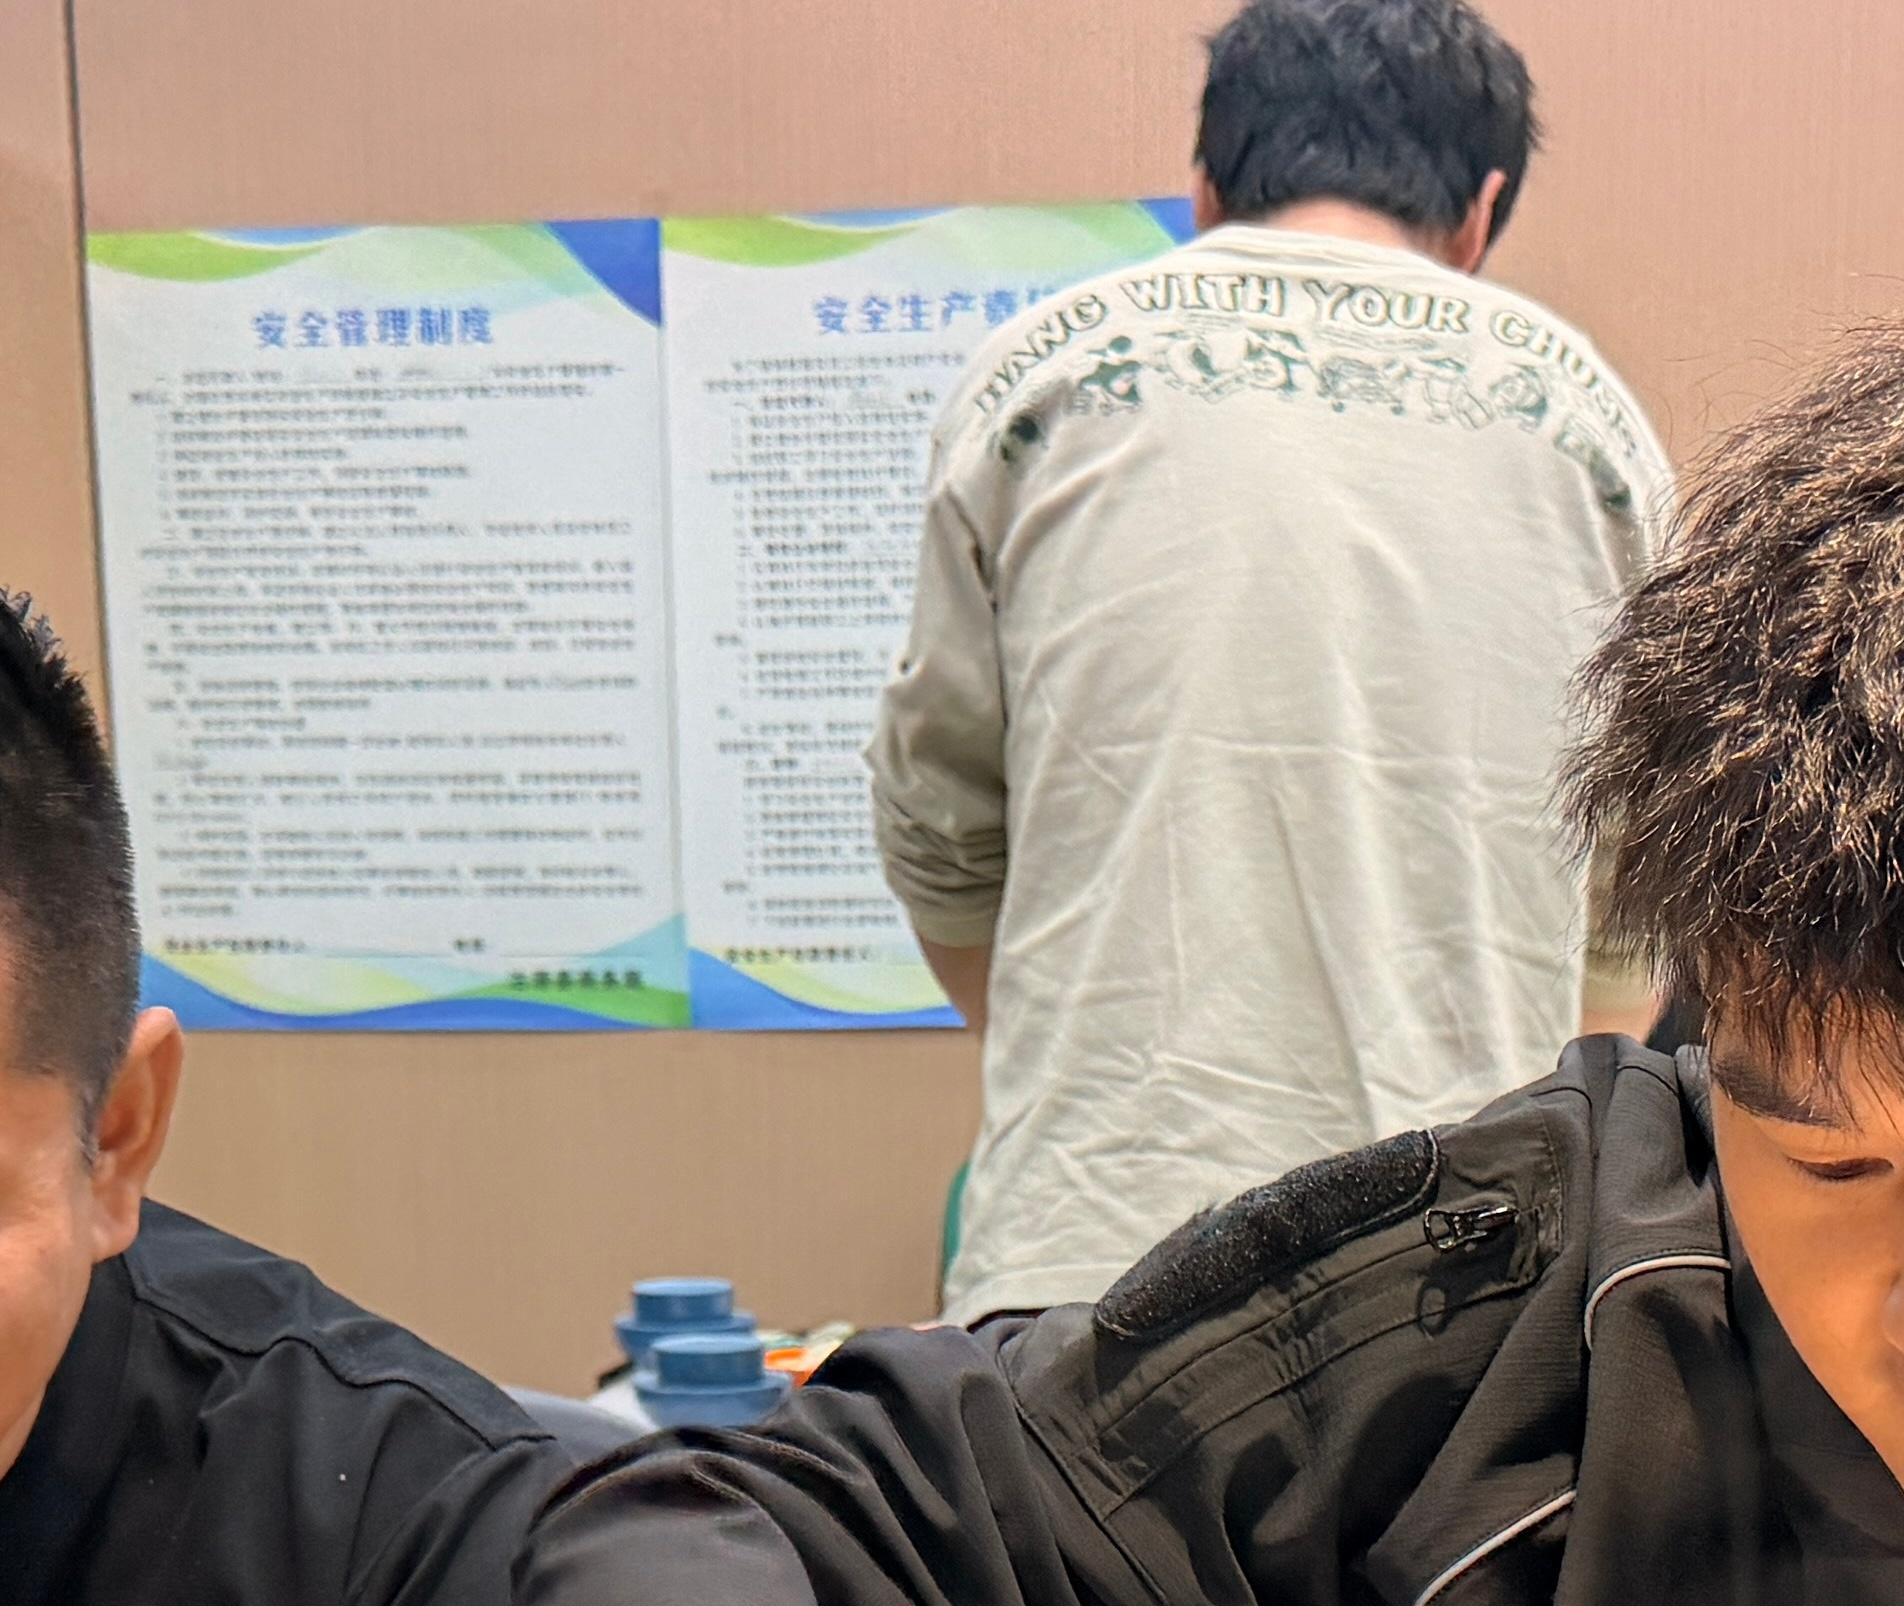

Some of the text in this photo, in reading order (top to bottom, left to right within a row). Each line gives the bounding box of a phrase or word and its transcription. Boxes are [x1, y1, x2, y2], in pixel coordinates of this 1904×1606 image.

[253, 305, 495, 350] 安全管理制度
[1119, 272, 1286, 318] WITH
[1301, 277, 1471, 333] YOUR
